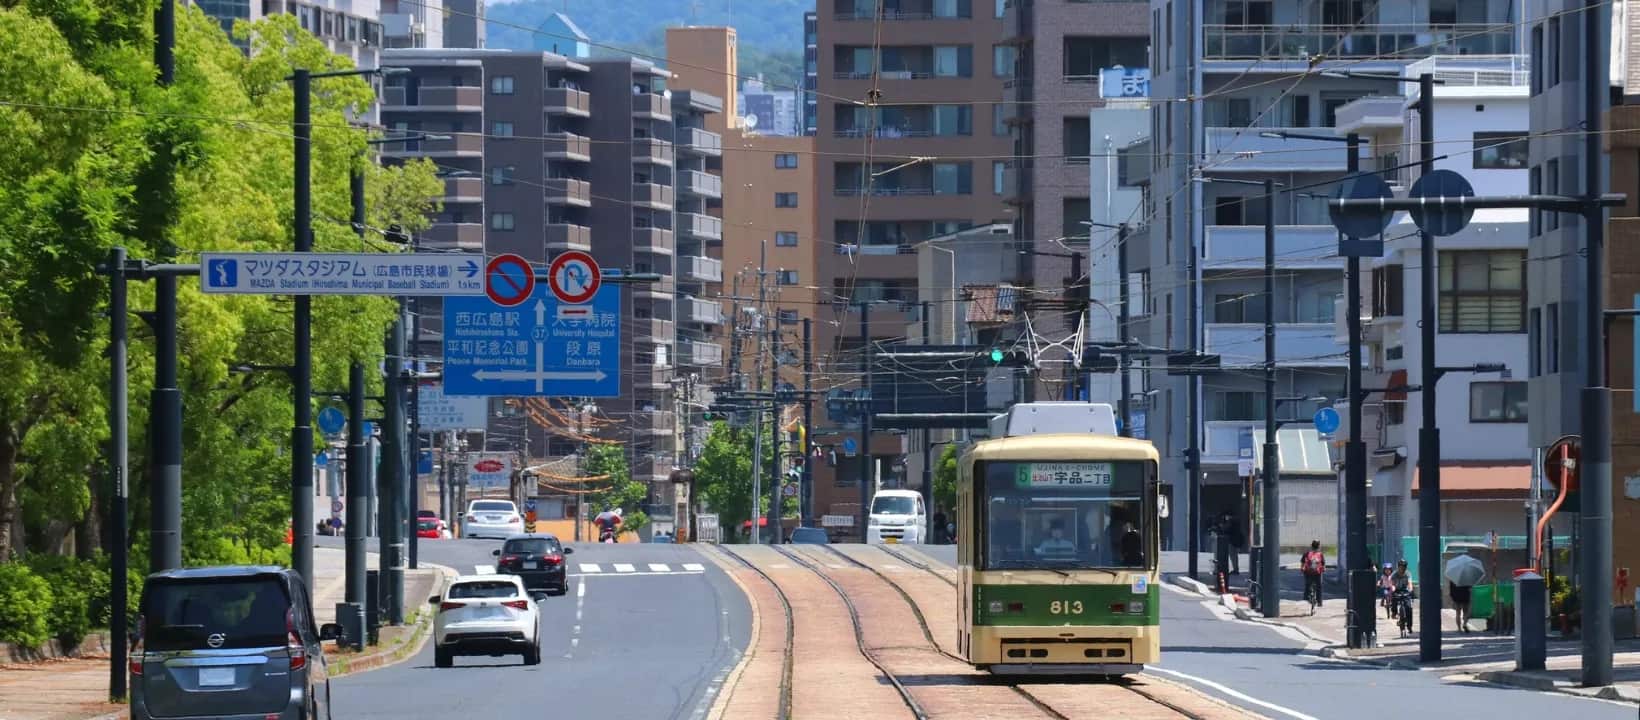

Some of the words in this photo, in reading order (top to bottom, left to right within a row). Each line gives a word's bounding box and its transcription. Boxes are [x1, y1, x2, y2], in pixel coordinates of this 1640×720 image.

[244, 260, 366, 276] マツダスタジアム
[250, 279, 275, 288] MAZDA
[280, 279, 309, 289] Stadium
[352, 279, 384, 291] Municipal
[388, 279, 416, 289] Baseball
[456, 312, 520, 326] 西広島駅
[534, 328, 545, 339] 37
[553, 328, 585, 339] University
[448, 340, 528, 355] 平和記念公園
[510, 356, 527, 365] Park
[566, 357, 601, 366] Danbara
[1050, 600, 1083, 615] 813
